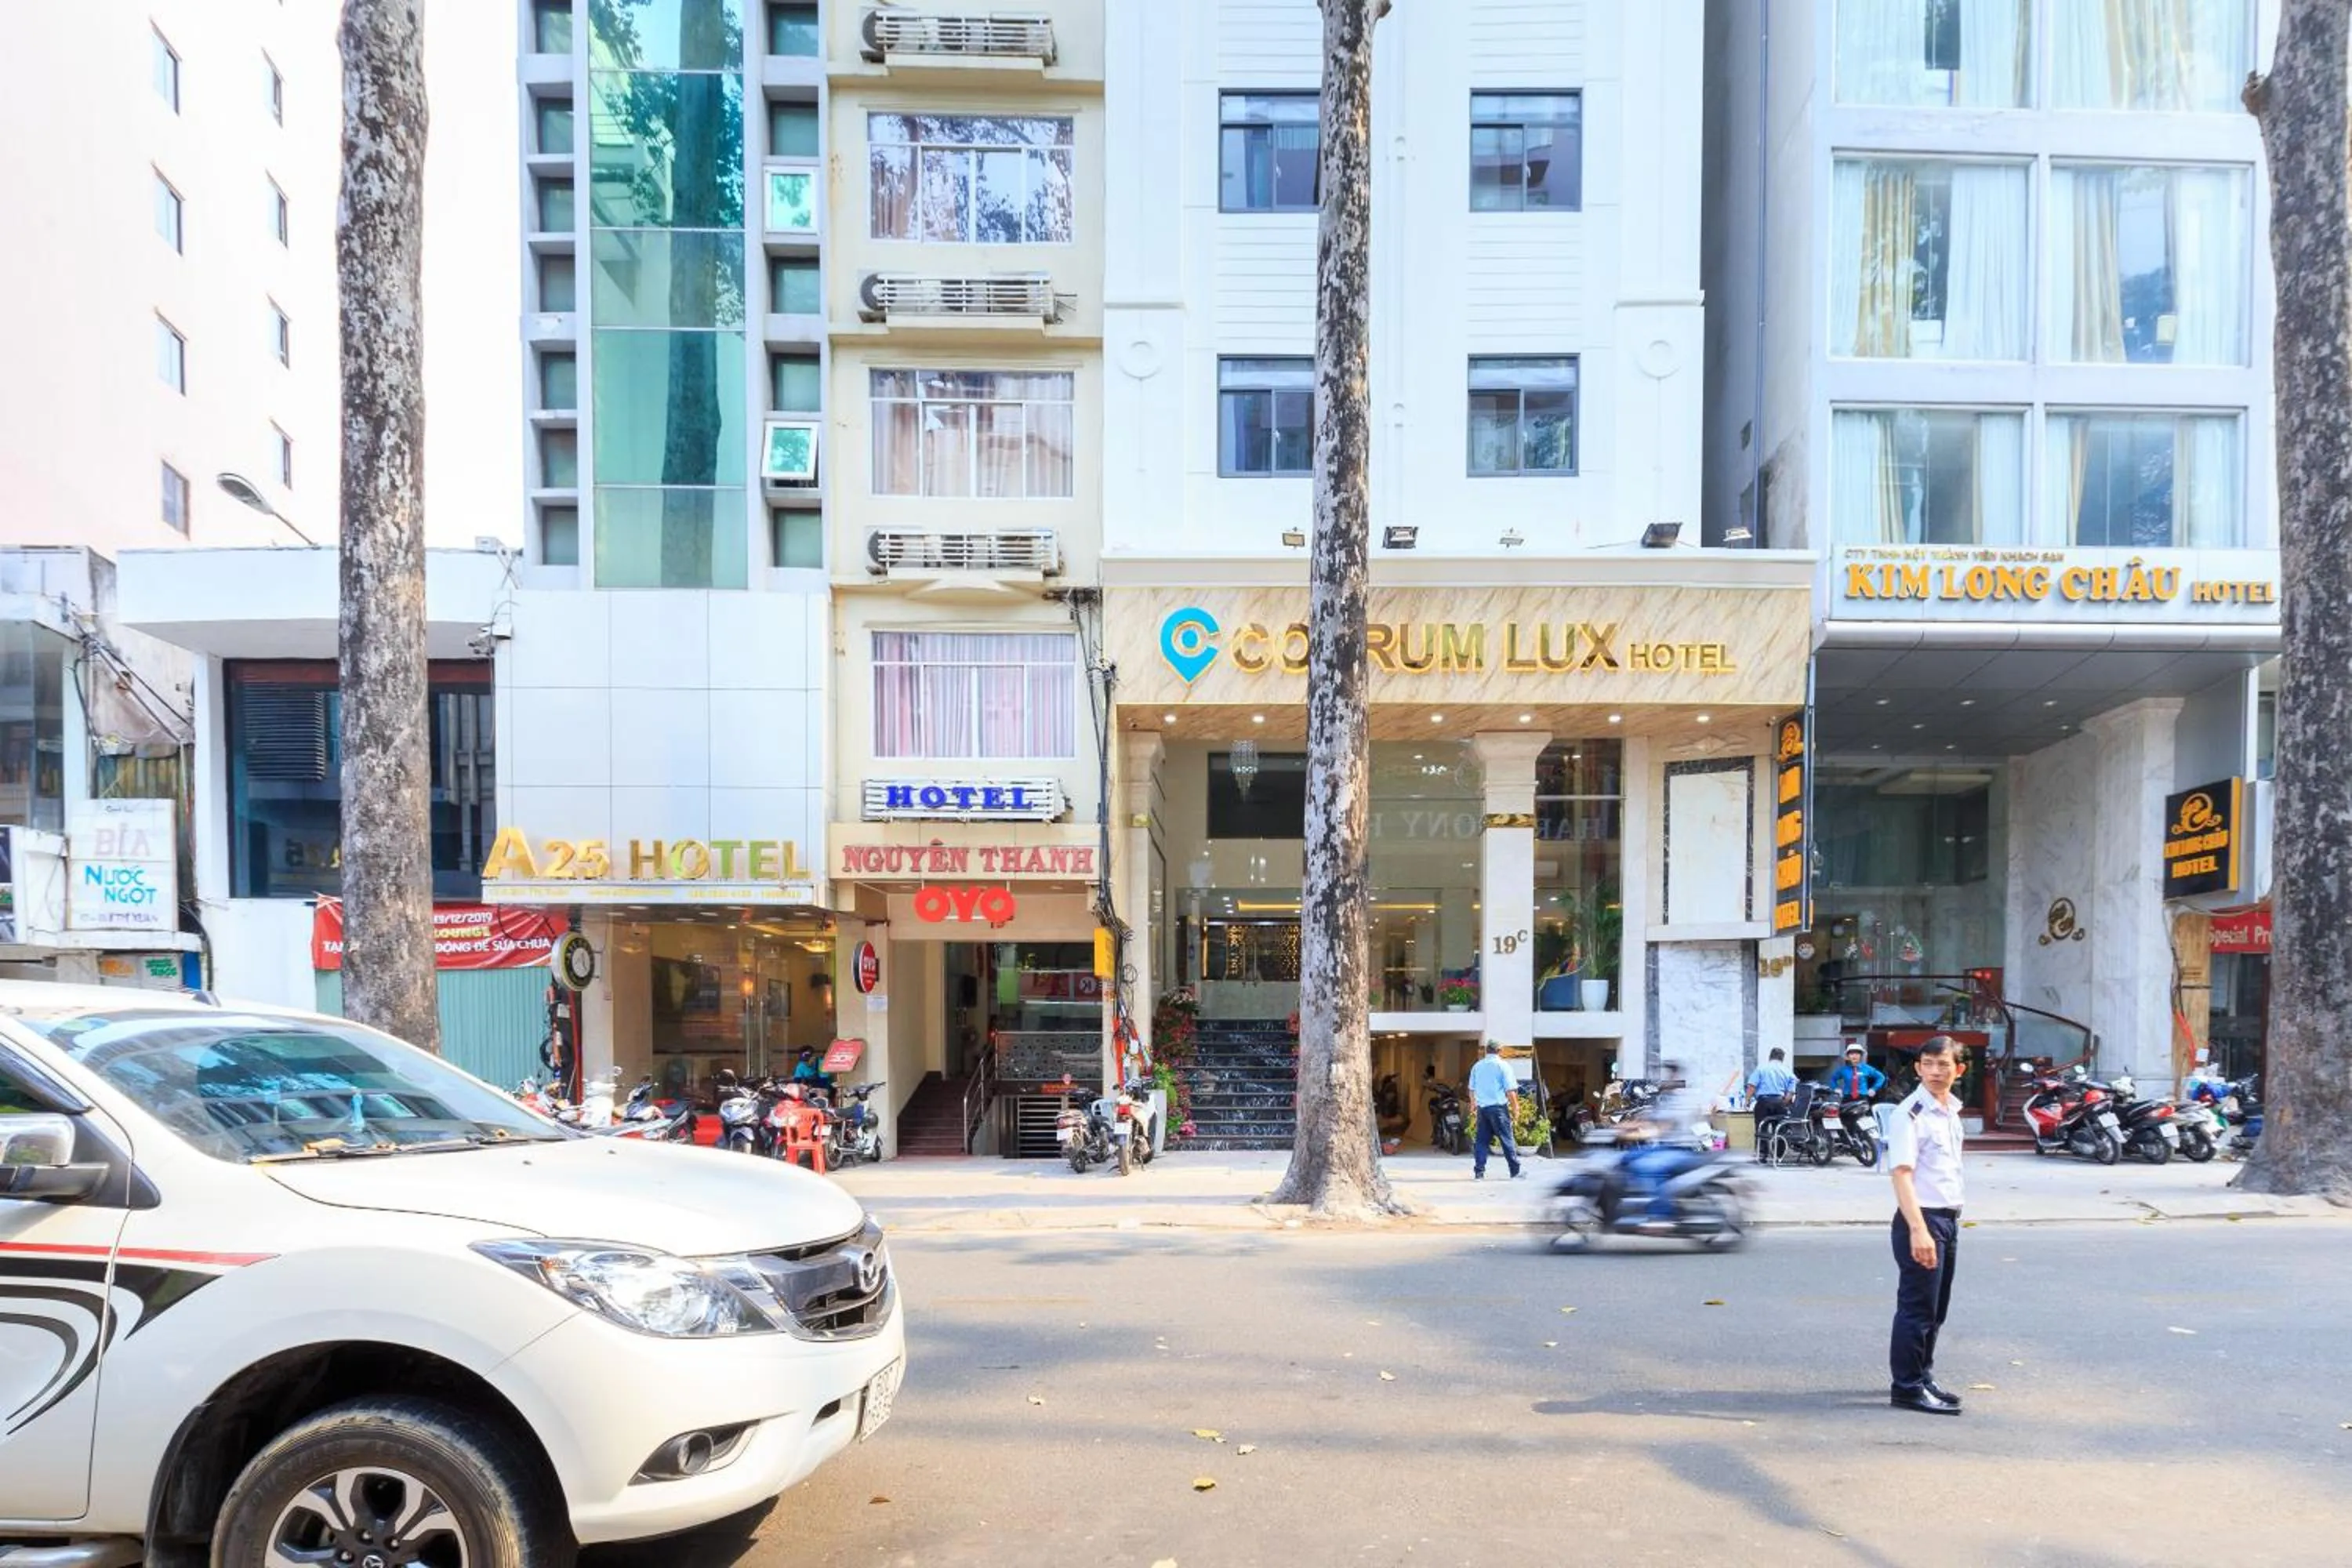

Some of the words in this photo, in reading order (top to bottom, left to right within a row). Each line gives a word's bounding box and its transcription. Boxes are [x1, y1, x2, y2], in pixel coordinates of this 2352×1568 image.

[1845, 563, 1930, 601] KIM
[1938, 564, 2051, 602] LONG
[2060, 556, 2183, 602] CHÂU
[2192, 580, 2275, 604] HOTEL
[1232, 622, 1486, 673] CORUM
[1504, 622, 1621, 673] LUX
[1628, 643, 1738, 673] HOTEL
[885, 785, 1035, 810] HOTEL
[481, 826, 611, 880] A25
[630, 839, 811, 880] HOTEL
[978, 845, 1094, 874] THANH
[914, 885, 1017, 923] OYO
